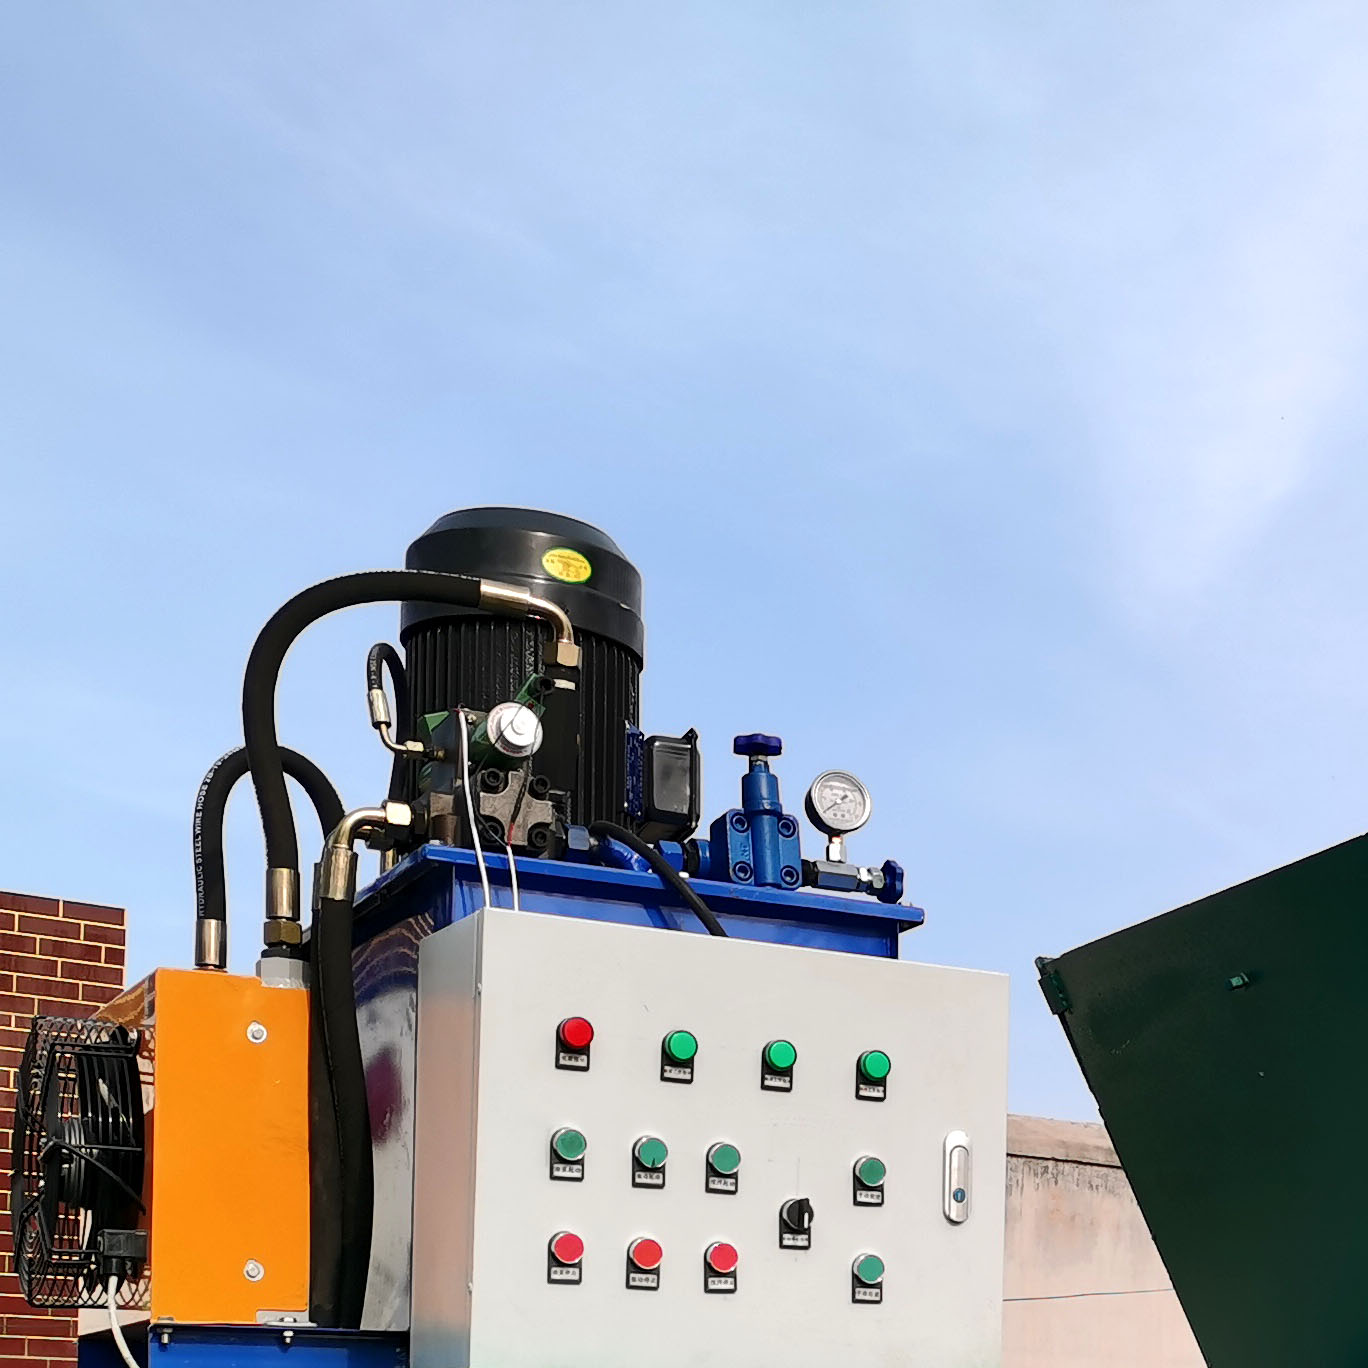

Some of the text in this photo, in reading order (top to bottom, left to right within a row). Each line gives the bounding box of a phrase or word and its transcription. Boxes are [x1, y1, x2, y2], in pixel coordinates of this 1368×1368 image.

[196, 784, 209, 810] HOSE
[195, 811, 203, 835] WIRE
[195, 835, 203, 864] STEEL
